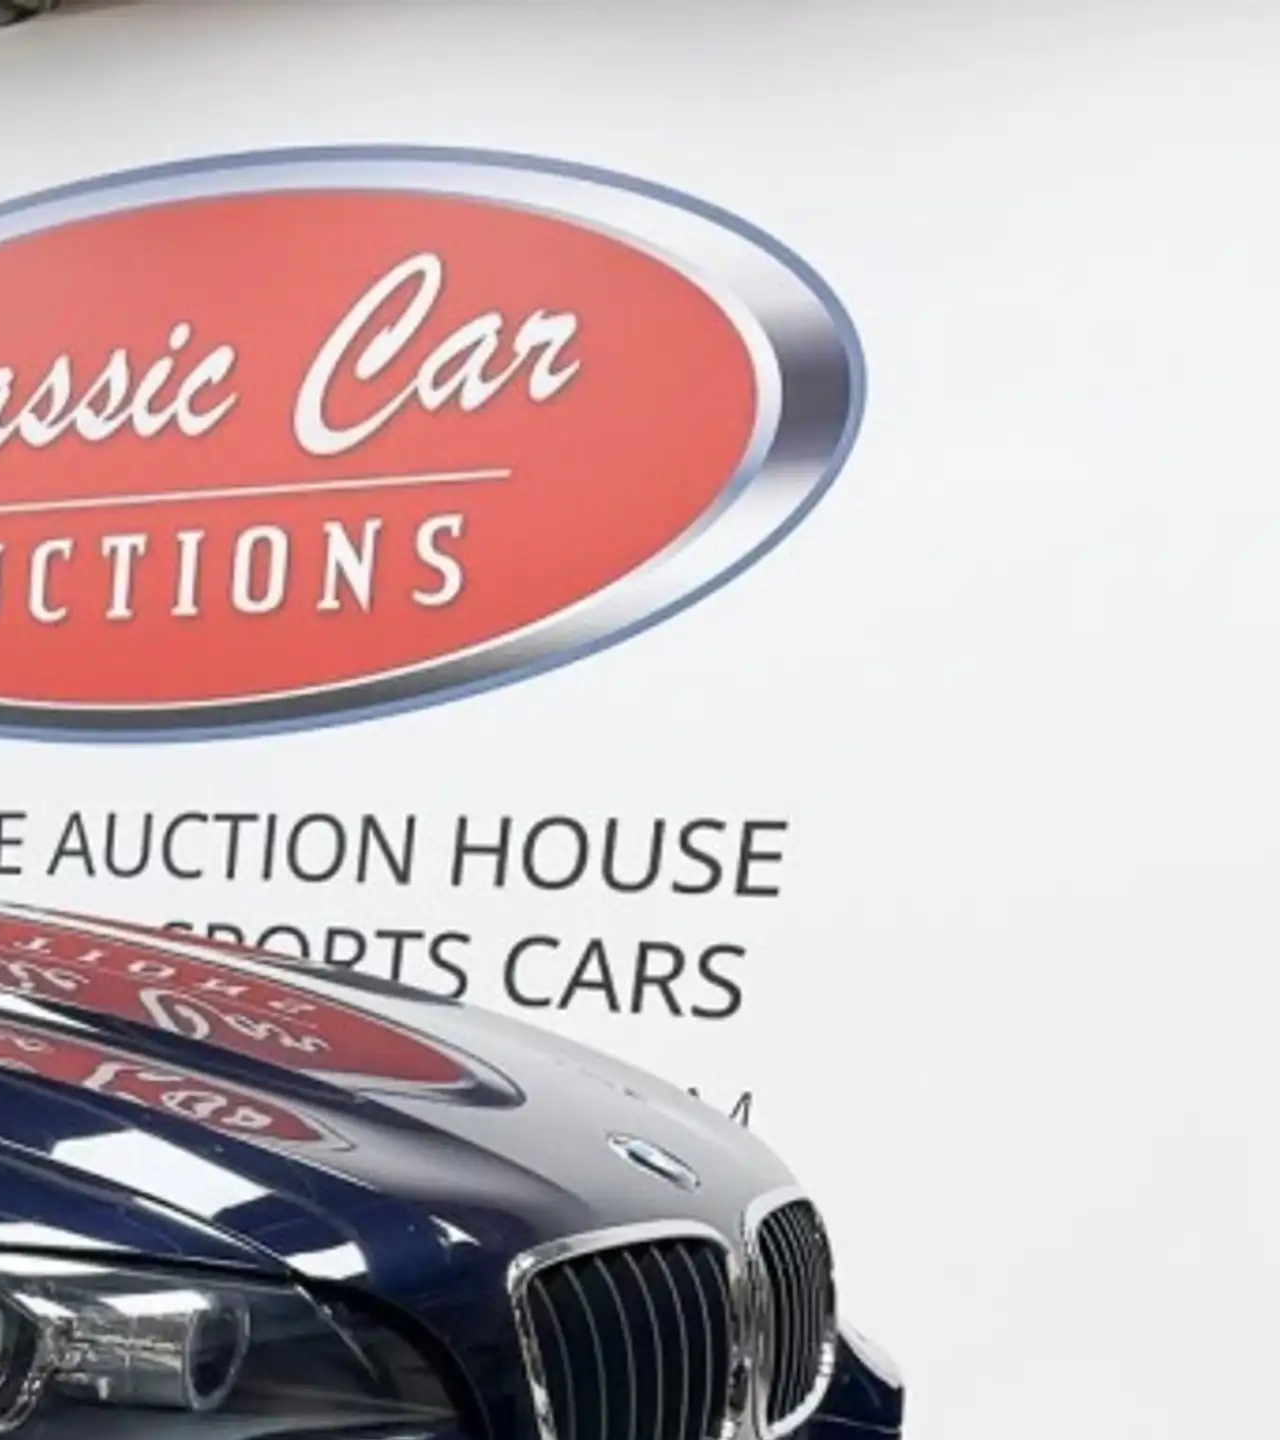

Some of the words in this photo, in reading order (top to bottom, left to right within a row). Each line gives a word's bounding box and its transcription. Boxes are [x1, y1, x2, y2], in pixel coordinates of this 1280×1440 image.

[293, 252, 581, 456] Car
[46, 812, 416, 885] AUCTION
[450, 815, 788, 897] HOUSE
[162, 921, 471, 999] RTS
[502, 936, 747, 1019] CARS
